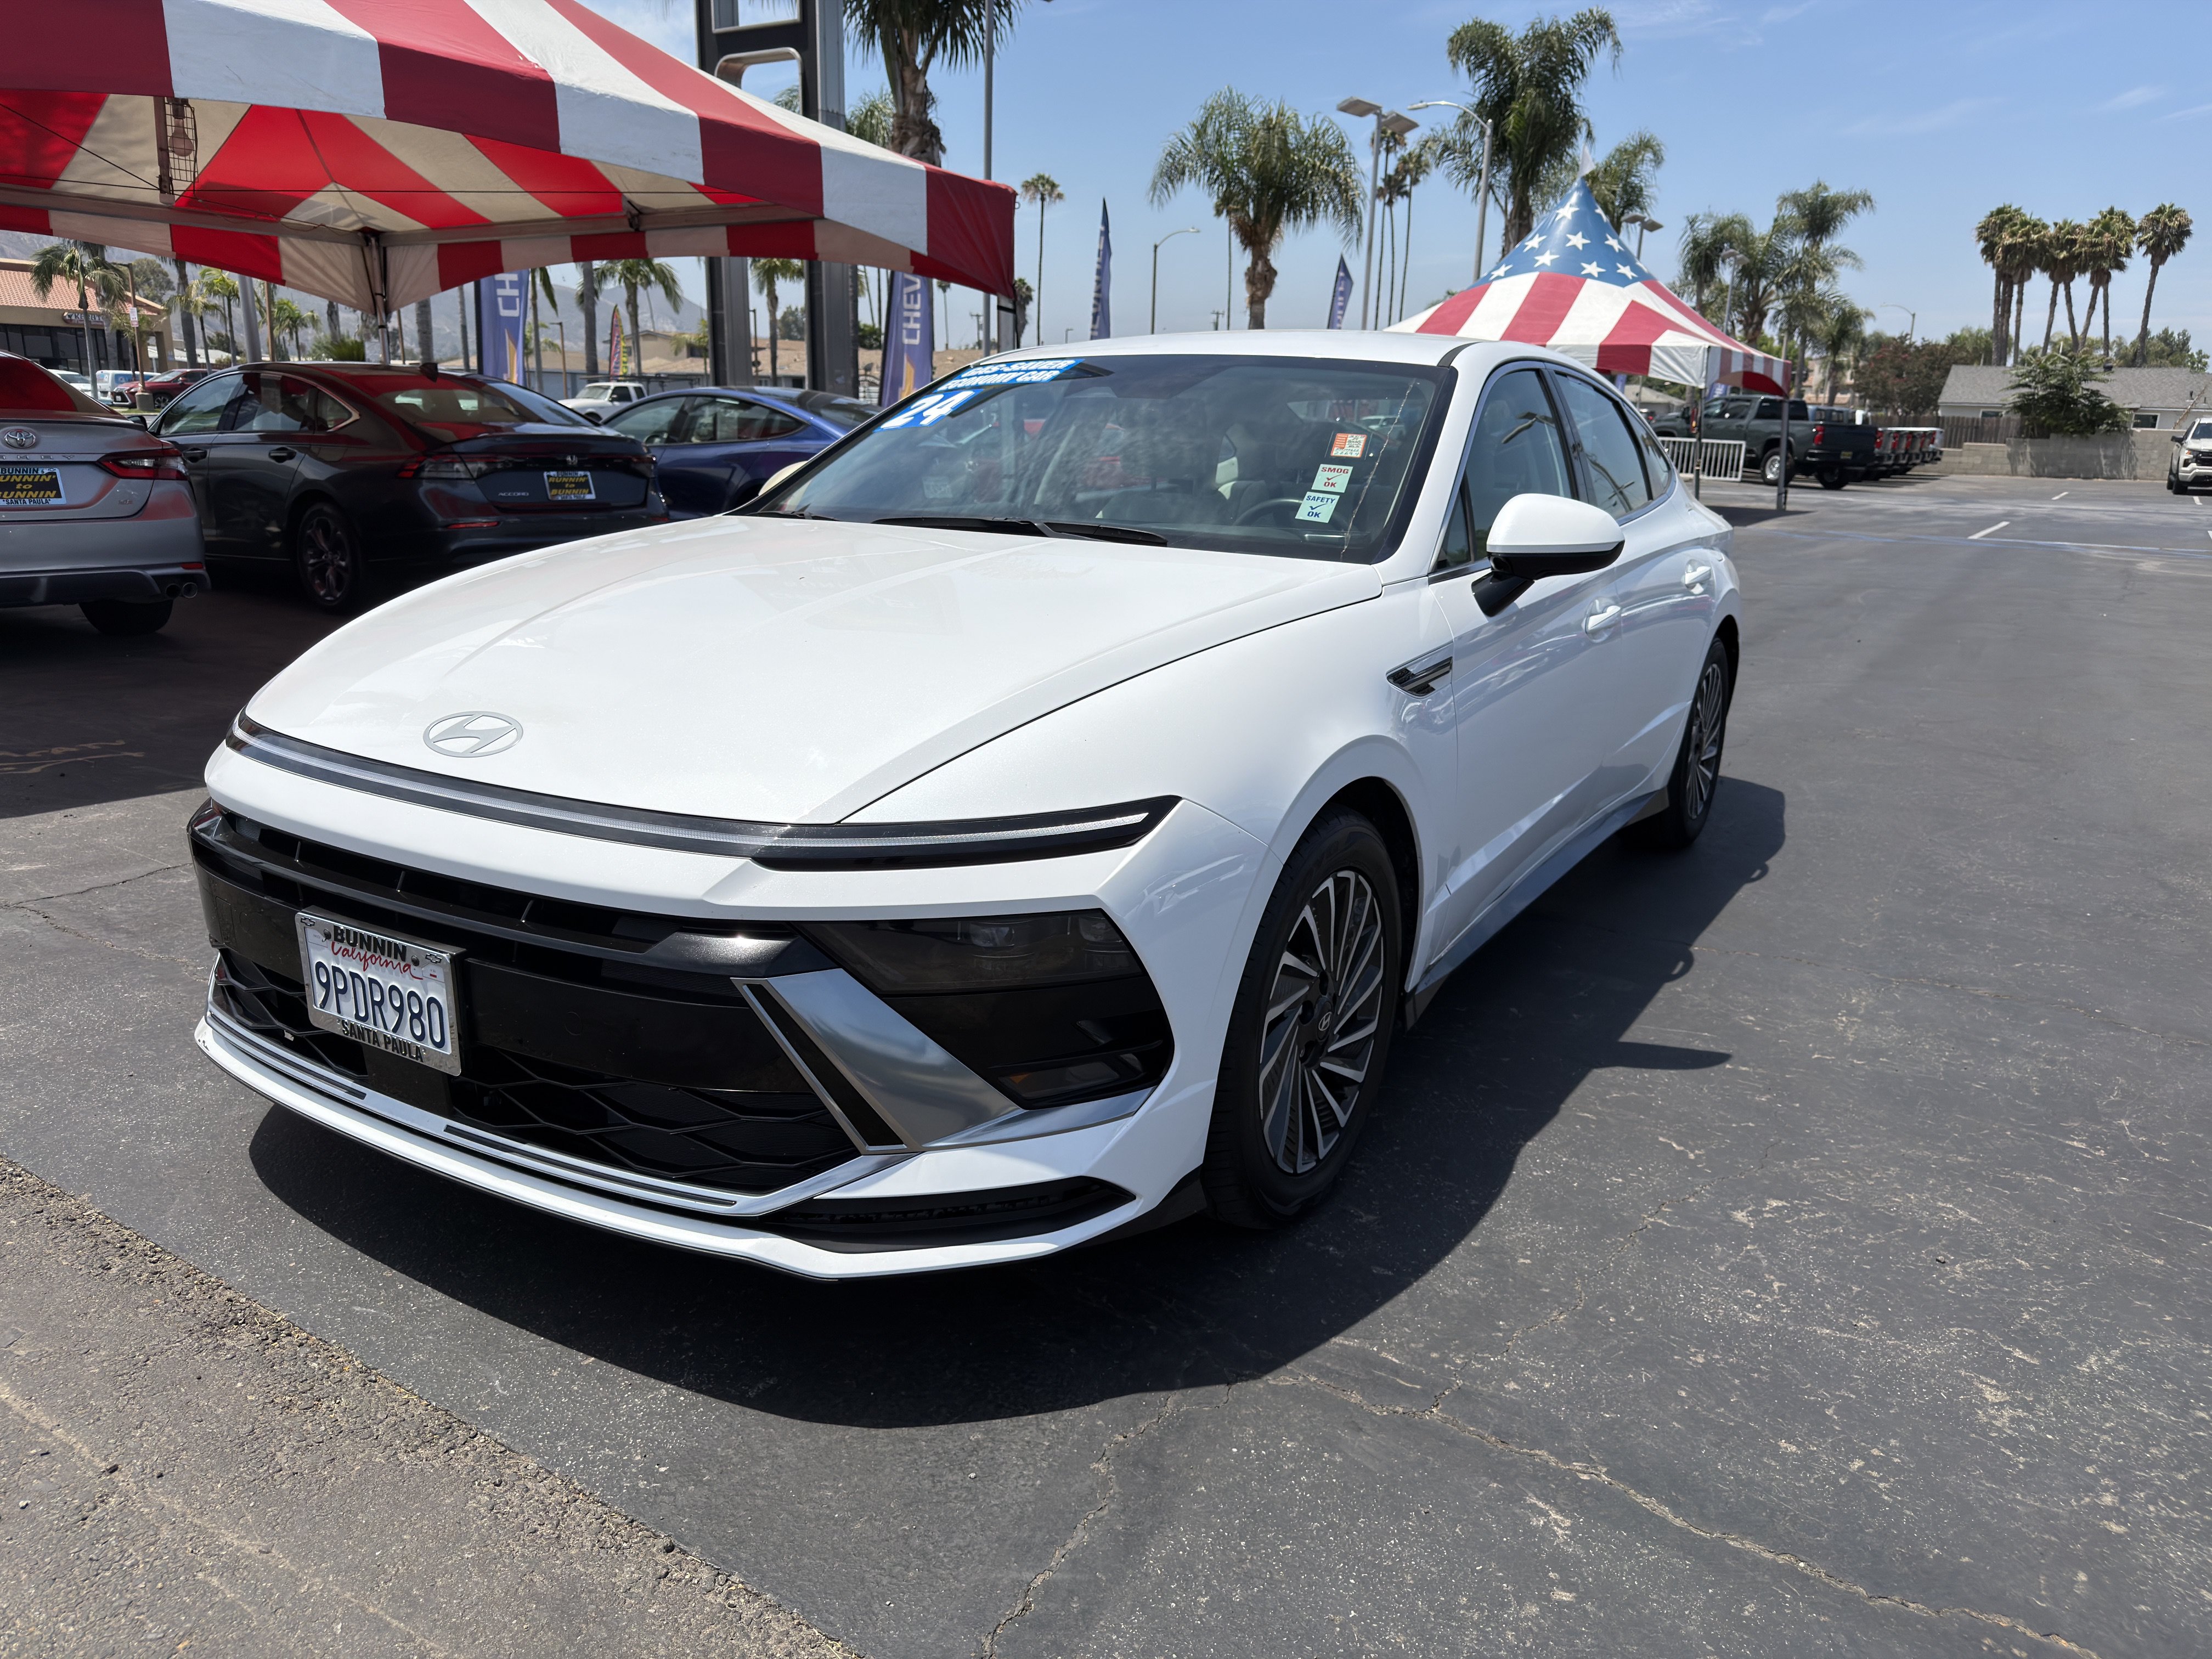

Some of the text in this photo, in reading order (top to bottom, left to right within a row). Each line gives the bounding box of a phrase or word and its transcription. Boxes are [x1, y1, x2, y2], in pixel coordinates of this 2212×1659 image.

[494, 274, 520, 317] CH
[902, 273, 921, 345] CHEV
[937, 370, 1060, 391] ECONOMY CAR
[961, 360, 1076, 378] GAS-SAVER
[880, 390, 975, 430] 24
[0, 490, 56, 499] UNNIN
[1306, 495, 1336, 504] SAFETY
[331, 941, 424, 980] California
[334, 924, 407, 962] BUNNIN
[315, 961, 445, 1049] 9PDR980
[342, 1019, 425, 1063] SANTA PAULA
